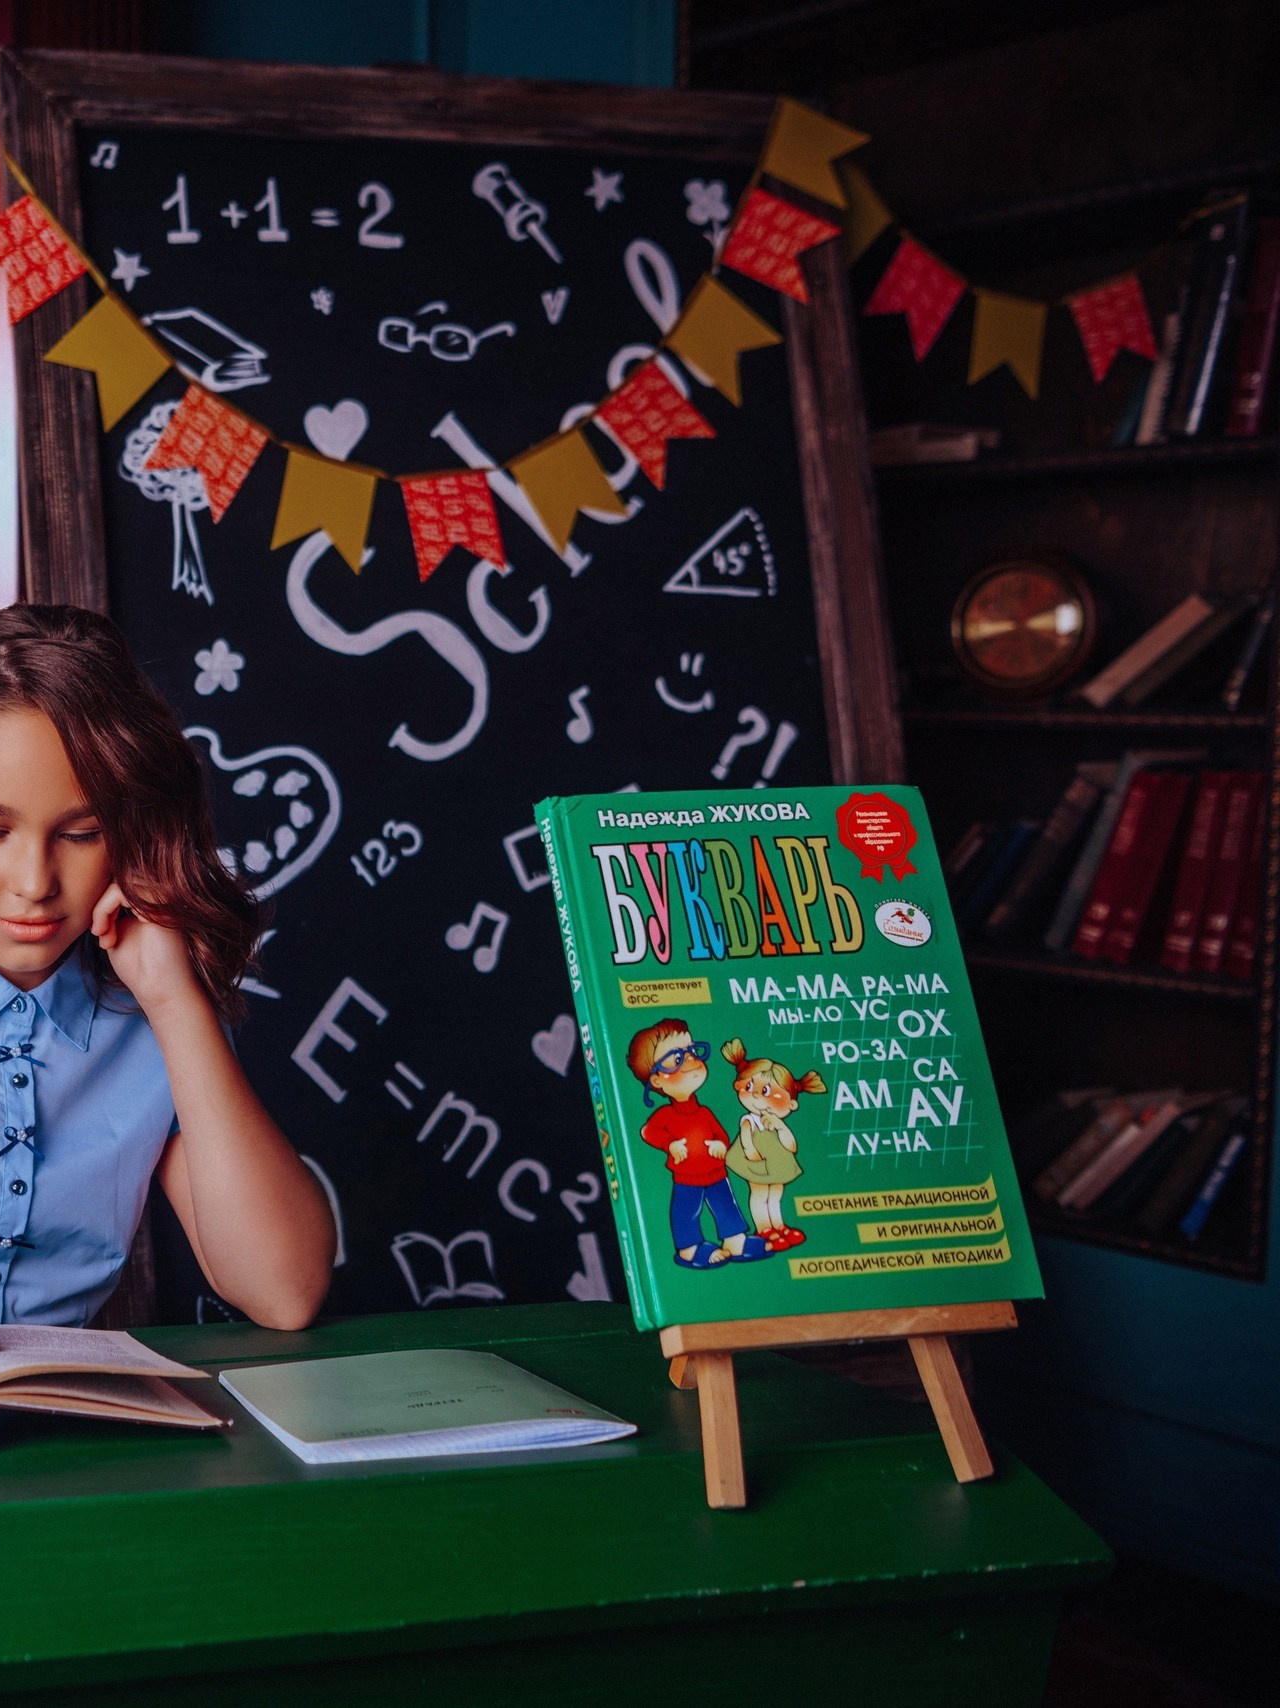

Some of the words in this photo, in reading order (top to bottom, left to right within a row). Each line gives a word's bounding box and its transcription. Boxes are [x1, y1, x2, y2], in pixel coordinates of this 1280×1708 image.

[162, 174, 200, 244] 1
[254, 176, 288, 242] 1
[358, 182, 405, 248] 2
[597, 809, 705, 829] Надежда
[707, 802, 811, 824] ЖУКОВА
[349, 820, 422, 887] 123
[540, 817, 564, 901] Надежда
[558, 904, 582, 993] ЖУКОВА
[590, 835, 865, 965] БУКВАРЬ
[625, 979, 703, 993] Соответствует
[627, 994, 659, 1005] ФГОС
[729, 973, 853, 1004] МА-МА
[862, 973, 949, 997] РА-МА
[768, 1005, 842, 1025] МЫ-ЛО
[850, 999, 890, 1021] УС
[897, 1008, 951, 1038] ОХ
[821, 1039, 907, 1064] РО-ЗА
[913, 1057, 958, 1082] СА
[834, 1079, 892, 1111] АМ
[907, 1085, 964, 1128] АУ
[847, 1130, 931, 1156] ЛУ-НА
[802, 1195, 879, 1212] СОЧЕТАНИЕ
[882, 1186, 989, 1206] ТРАДИЦИОННОЙ
[877, 1226, 887, 1238] И
[890, 1216, 997, 1237] ОРИГИНАЛЬНОЙ
[799, 1252, 925, 1275] ЛОГОПЕДИЧЕСКОЙ
[932, 1248, 1004, 1265] МЕТОДИКИ
